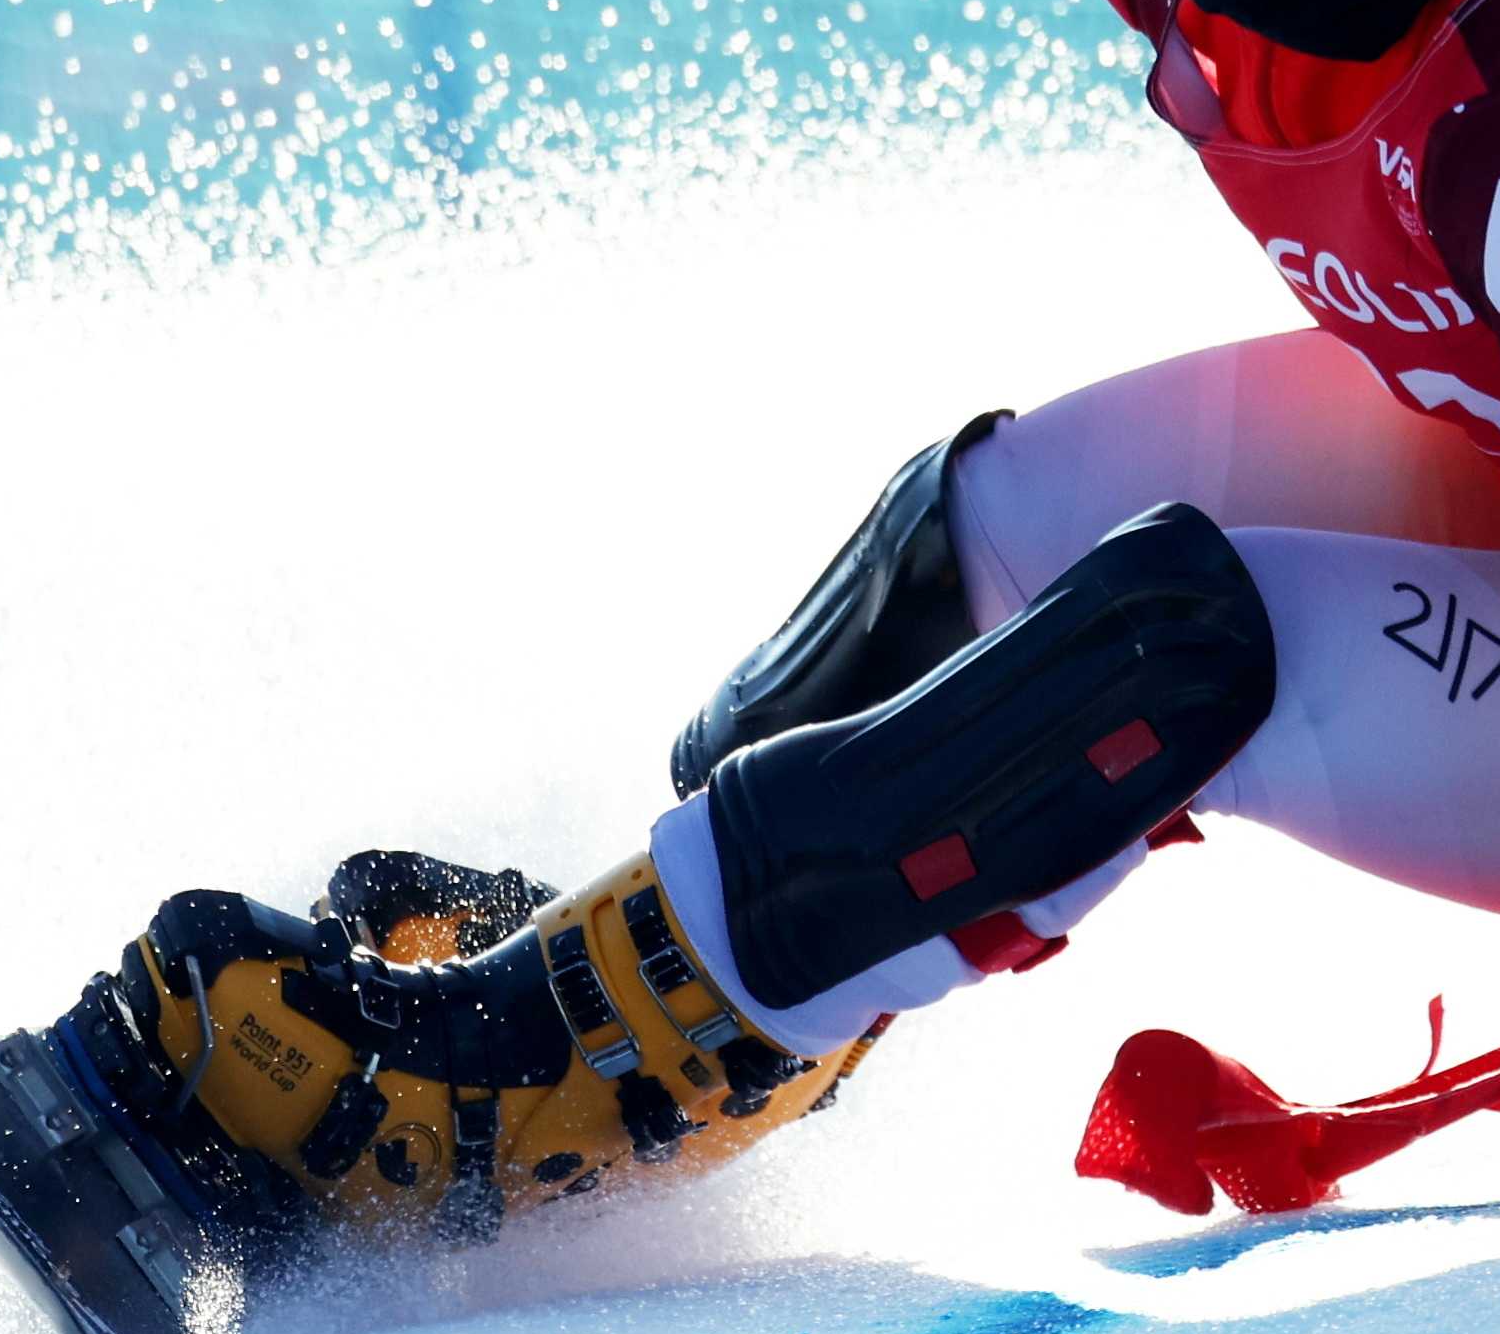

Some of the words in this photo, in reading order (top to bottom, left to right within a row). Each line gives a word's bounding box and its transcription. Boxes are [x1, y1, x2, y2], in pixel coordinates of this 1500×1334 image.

[230, 1034, 272, 1071] World
[269, 1068, 296, 1091] Cup
[285, 1047, 313, 1076] 951
